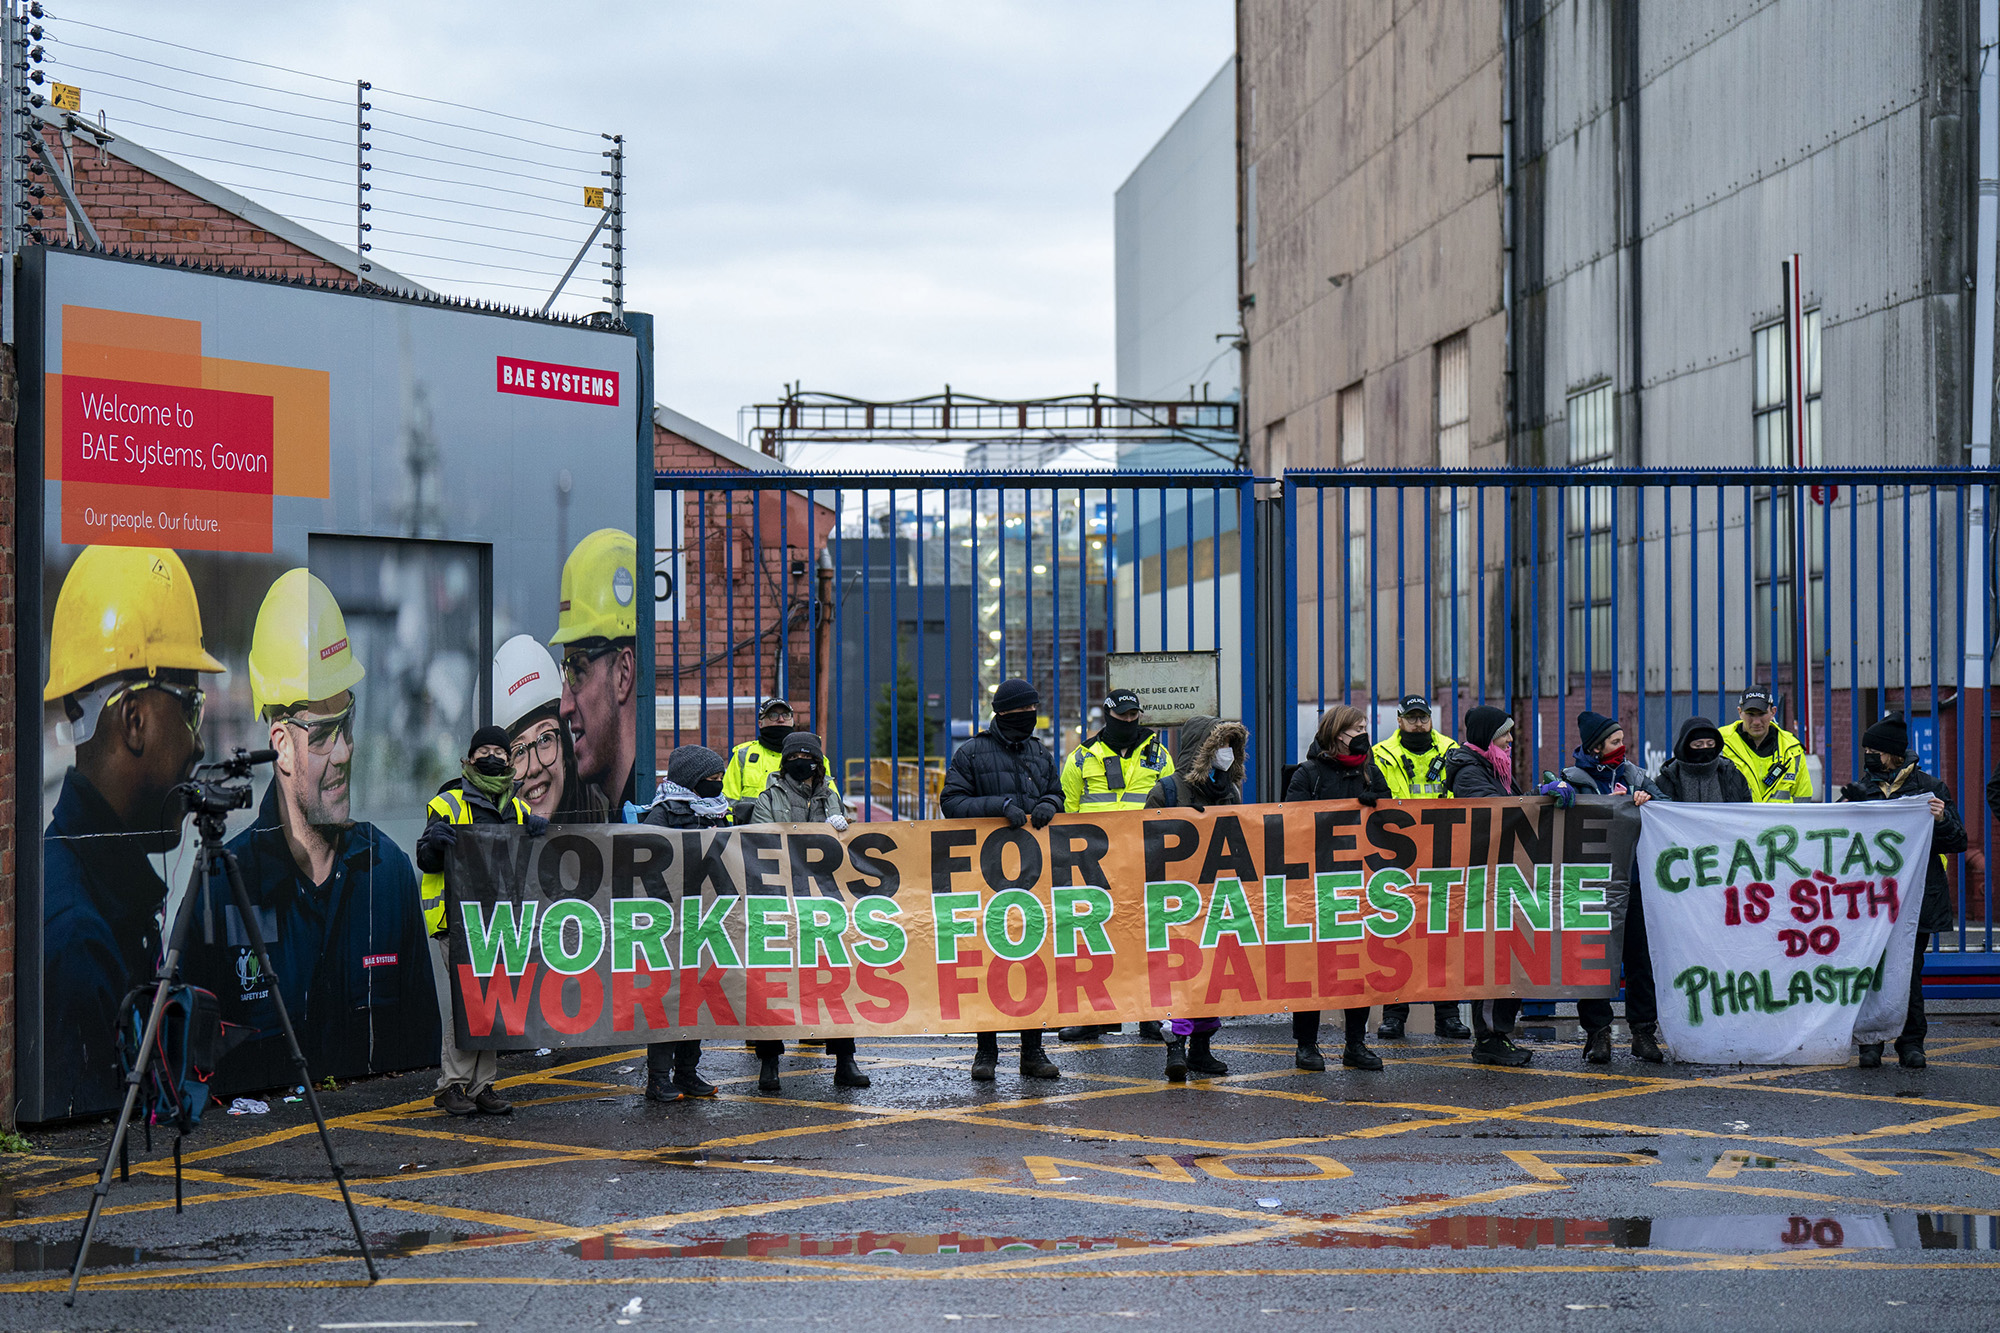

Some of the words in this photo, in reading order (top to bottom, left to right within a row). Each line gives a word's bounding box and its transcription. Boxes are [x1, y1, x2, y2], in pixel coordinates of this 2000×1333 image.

[503, 365, 535, 388] BAE
[541, 370, 614, 398] SYSTEMS
[81, 391, 171, 427] Welcome
[176, 402, 194, 428] to
[82, 432, 119, 462] BAE
[124, 435, 207, 473] Systems,
[211, 442, 268, 473] Govan
[84, 507, 109, 526] Our
[111, 510, 155, 533] people.
[158, 511, 180, 530] Our
[183, 512, 221, 532] future.
[1141, 655, 1152, 663] NO
[1154, 655, 1178, 663] ENTRY
[1118, 695, 1137, 703] POLICE
[1129, 687, 1150, 695] EASE
[1168, 686, 1188, 694] GATE
[463, 831, 901, 902] WORKERS
[931, 823, 1112, 893] FOR
[1142, 804, 1614, 884] PALESTINE
[1655, 824, 1905, 893] CEARTAS
[1724, 882, 1774, 926] IS
[1789, 869, 1899, 924] SÌTH
[459, 895, 908, 977] WORKERS
[931, 885, 1116, 964] FOR
[1144, 863, 1612, 952] PALESTINE
[1777, 925, 1840, 957] DO
[241, 992, 258, 1001] SAFETY
[259, 990, 269, 999] 1ST
[457, 956, 910, 1037] WORKERS
[937, 943, 1117, 1021] FOR
[1147, 921, 1611, 1008] PALESTINE
[1023, 1153, 1354, 1184] NO
